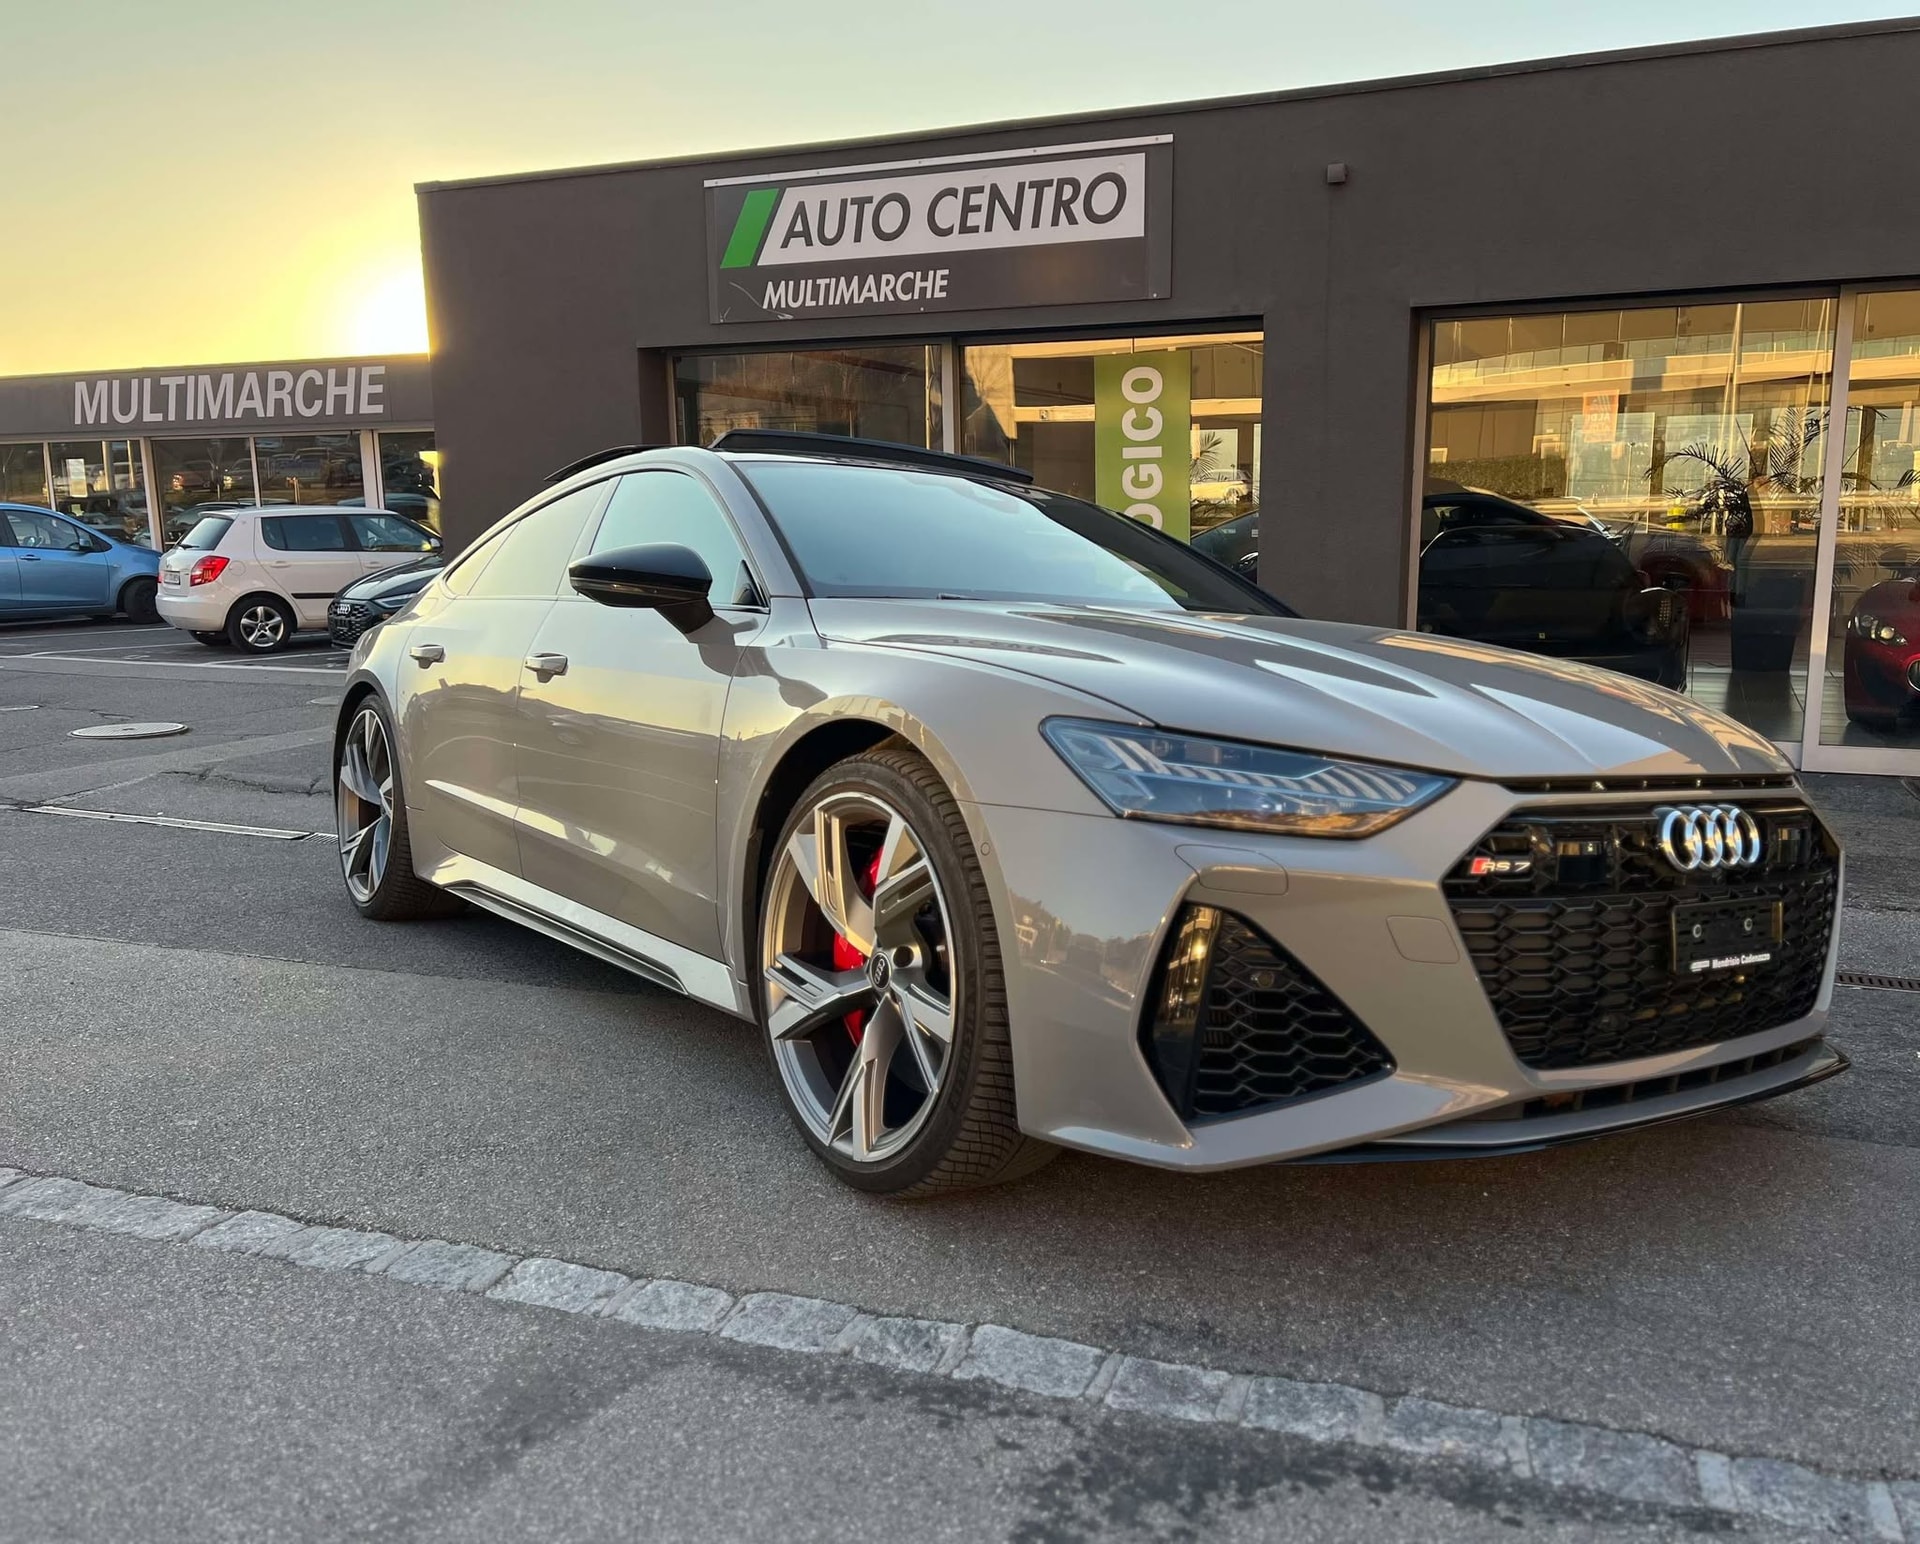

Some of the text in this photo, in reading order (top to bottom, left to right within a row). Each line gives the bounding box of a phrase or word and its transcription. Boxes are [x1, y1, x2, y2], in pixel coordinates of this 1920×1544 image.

[780, 171, 1128, 249] AUTO CENTRO
[762, 268, 950, 309] MULTIMARCHE
[74, 365, 386, 424] MULTIMARCHE
[1121, 366, 1164, 532] OGICO
